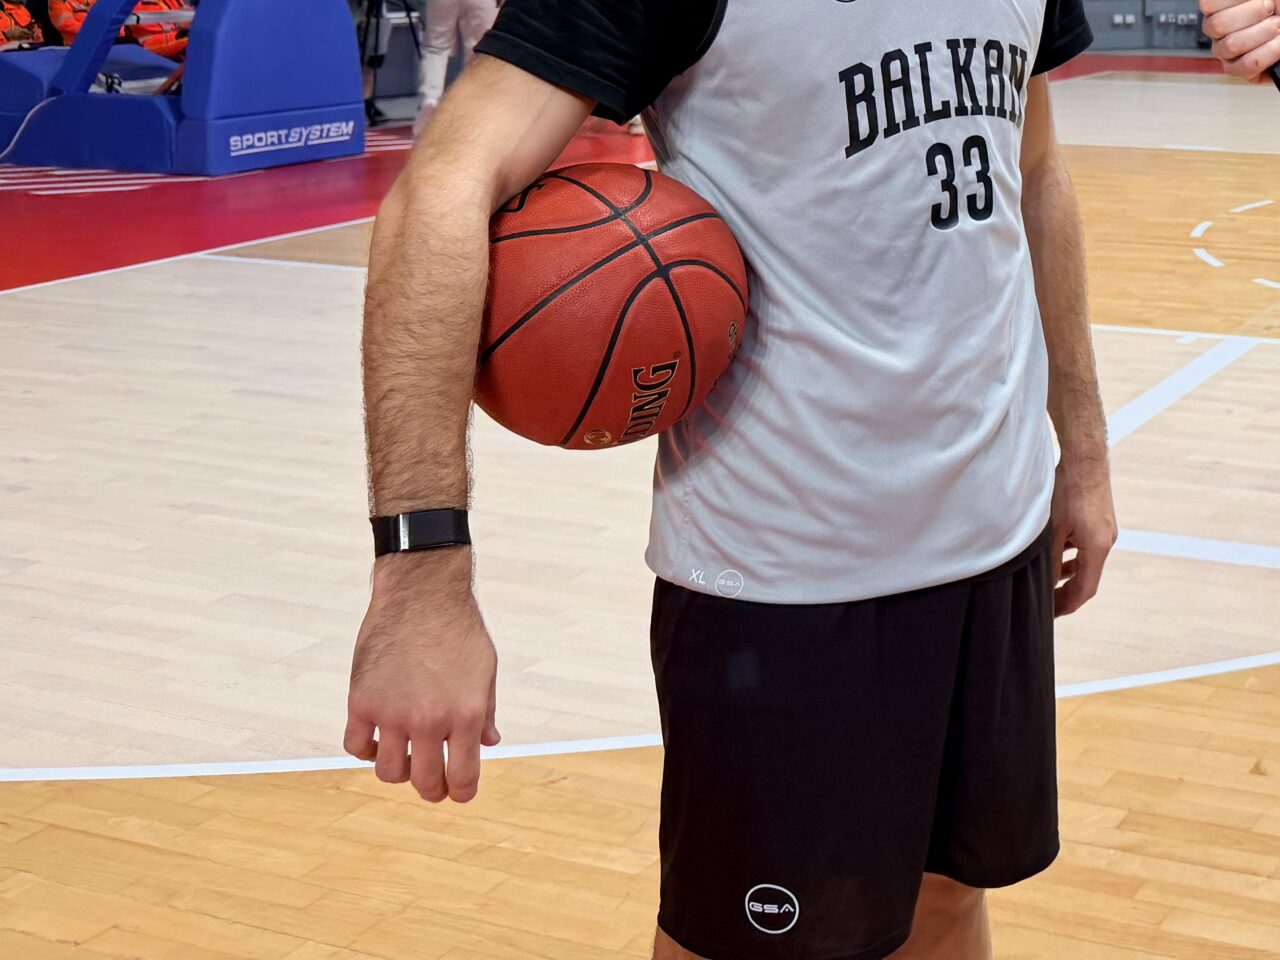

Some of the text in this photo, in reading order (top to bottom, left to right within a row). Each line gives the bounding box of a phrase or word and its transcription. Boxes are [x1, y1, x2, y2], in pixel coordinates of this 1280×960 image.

[838, 38, 1028, 159] BALKAN
[230, 120, 354, 153] SPORTSYSTEM
[925, 134, 994, 231] 33
[619, 359, 680, 443] DING
[688, 568, 706, 585] XL
[749, 901, 795, 913] GSA
